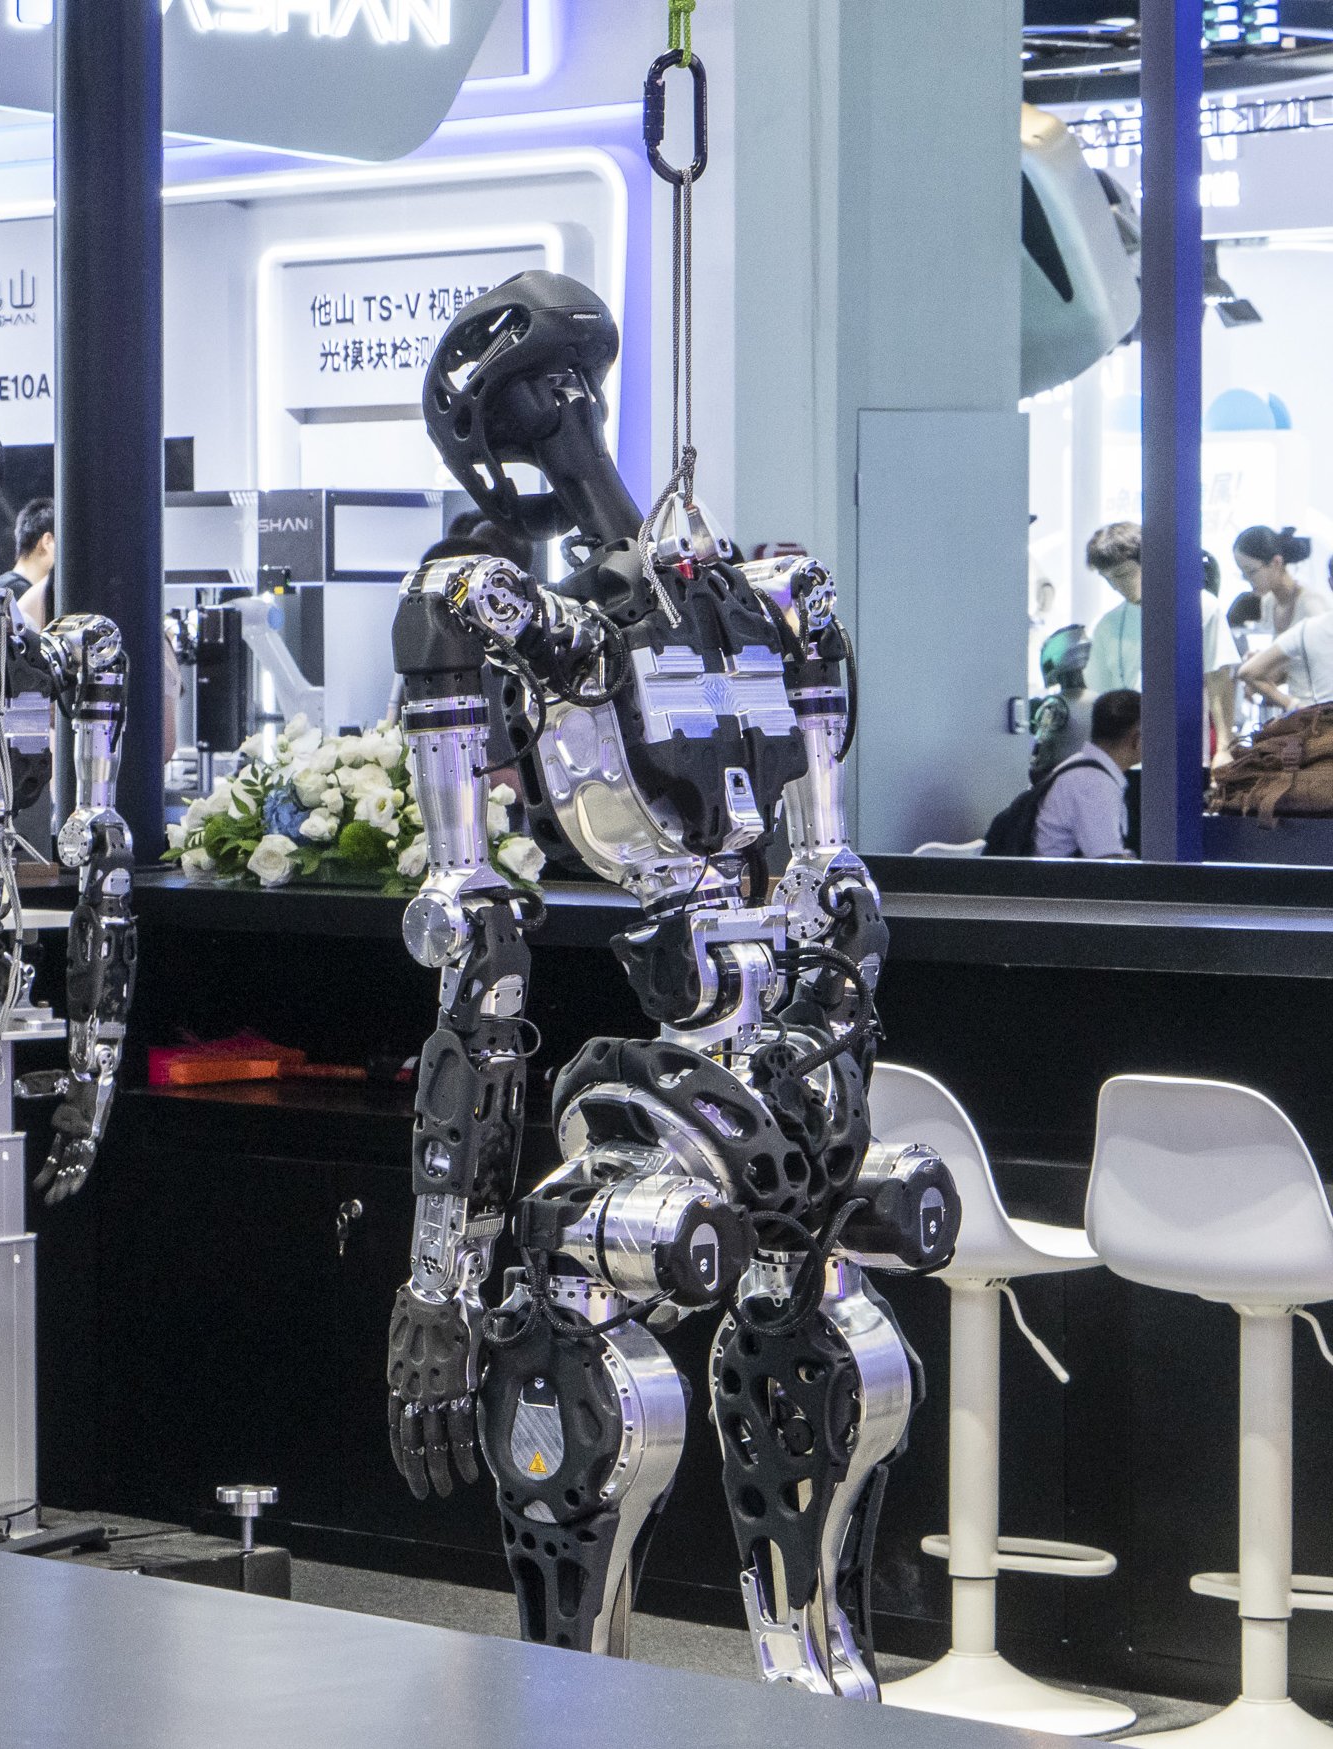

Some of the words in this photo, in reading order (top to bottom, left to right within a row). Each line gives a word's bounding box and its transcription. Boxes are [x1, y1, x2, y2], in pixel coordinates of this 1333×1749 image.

[311, 294, 355, 327] 他山
[364, 293, 421, 322] TS-V
[429, 284, 498, 321] 视触
